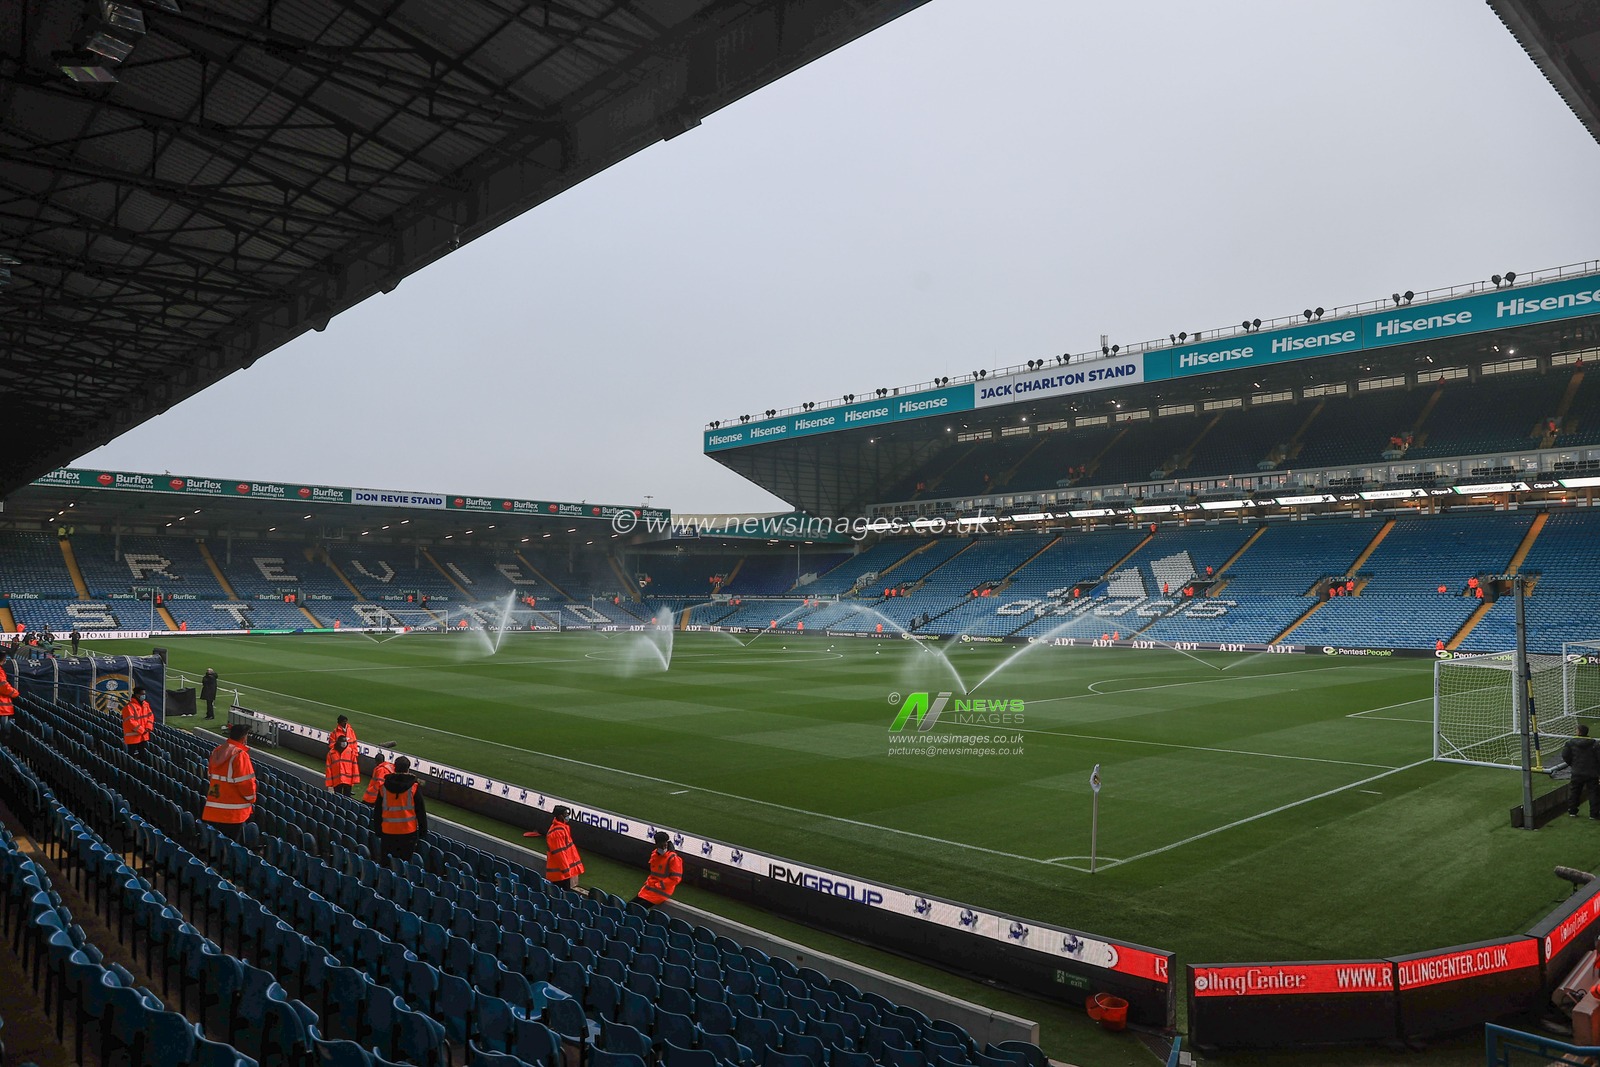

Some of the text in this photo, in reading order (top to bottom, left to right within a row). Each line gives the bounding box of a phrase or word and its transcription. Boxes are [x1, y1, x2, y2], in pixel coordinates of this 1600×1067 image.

[1376, 310, 1472, 338] Hisense
[1272, 330, 1356, 354] Hisense
[1180, 346, 1254, 368] Hisense
[981, 364, 1136, 400] JACK CHARLTON STAND
[899, 396, 948, 413] Hisense
[844, 406, 888, 422] Hisense
[795, 414, 835, 430] Hisense
[750, 423, 786, 438] Hisense
[709, 432, 742, 446] Hisense
[43, 470, 80, 480] urflex
[116, 474, 153, 484] Burflex
[186, 479, 221, 489] Burflex
[252, 484, 284, 494] Burflex
[313, 488, 343, 498] Burflex
[356, 493, 442, 505] DON REVIE STAND
[466, 498, 491, 506] Burflex
[1054, 638, 1076, 646] ADT
[1092, 639, 1114, 647] ADT
[1132, 640, 1156, 649] ADT
[1175, 642, 1199, 651] ADT
[1219, 643, 1246, 652] ADT
[1266, 645, 1294, 653] ADT
[1339, 648, 1392, 657] PentestPeople
[1398, 948, 1508, 986] OLLINGCENTER.CO.UK
